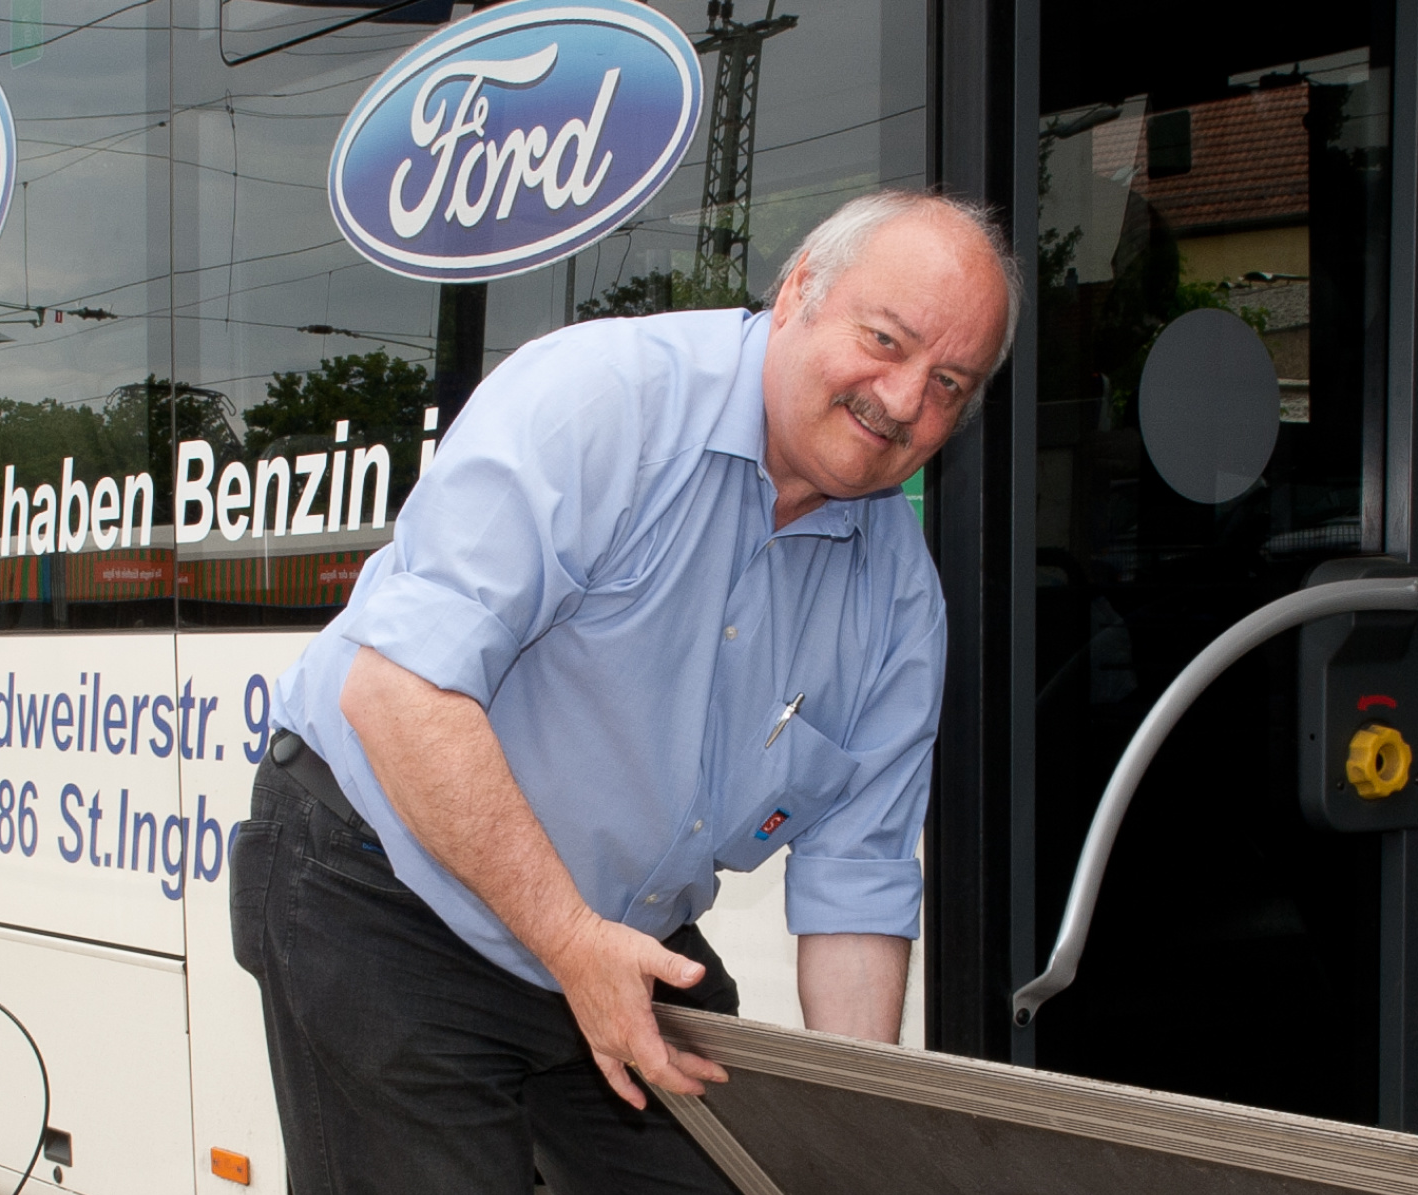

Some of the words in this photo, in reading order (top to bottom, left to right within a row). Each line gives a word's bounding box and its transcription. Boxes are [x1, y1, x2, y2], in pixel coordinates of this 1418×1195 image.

[389, 42, 621, 239] Ford
[1, 457, 154, 556] haben
[176, 420, 390, 544] Benzin
[57, 784, 241, 900] St.Ingb
